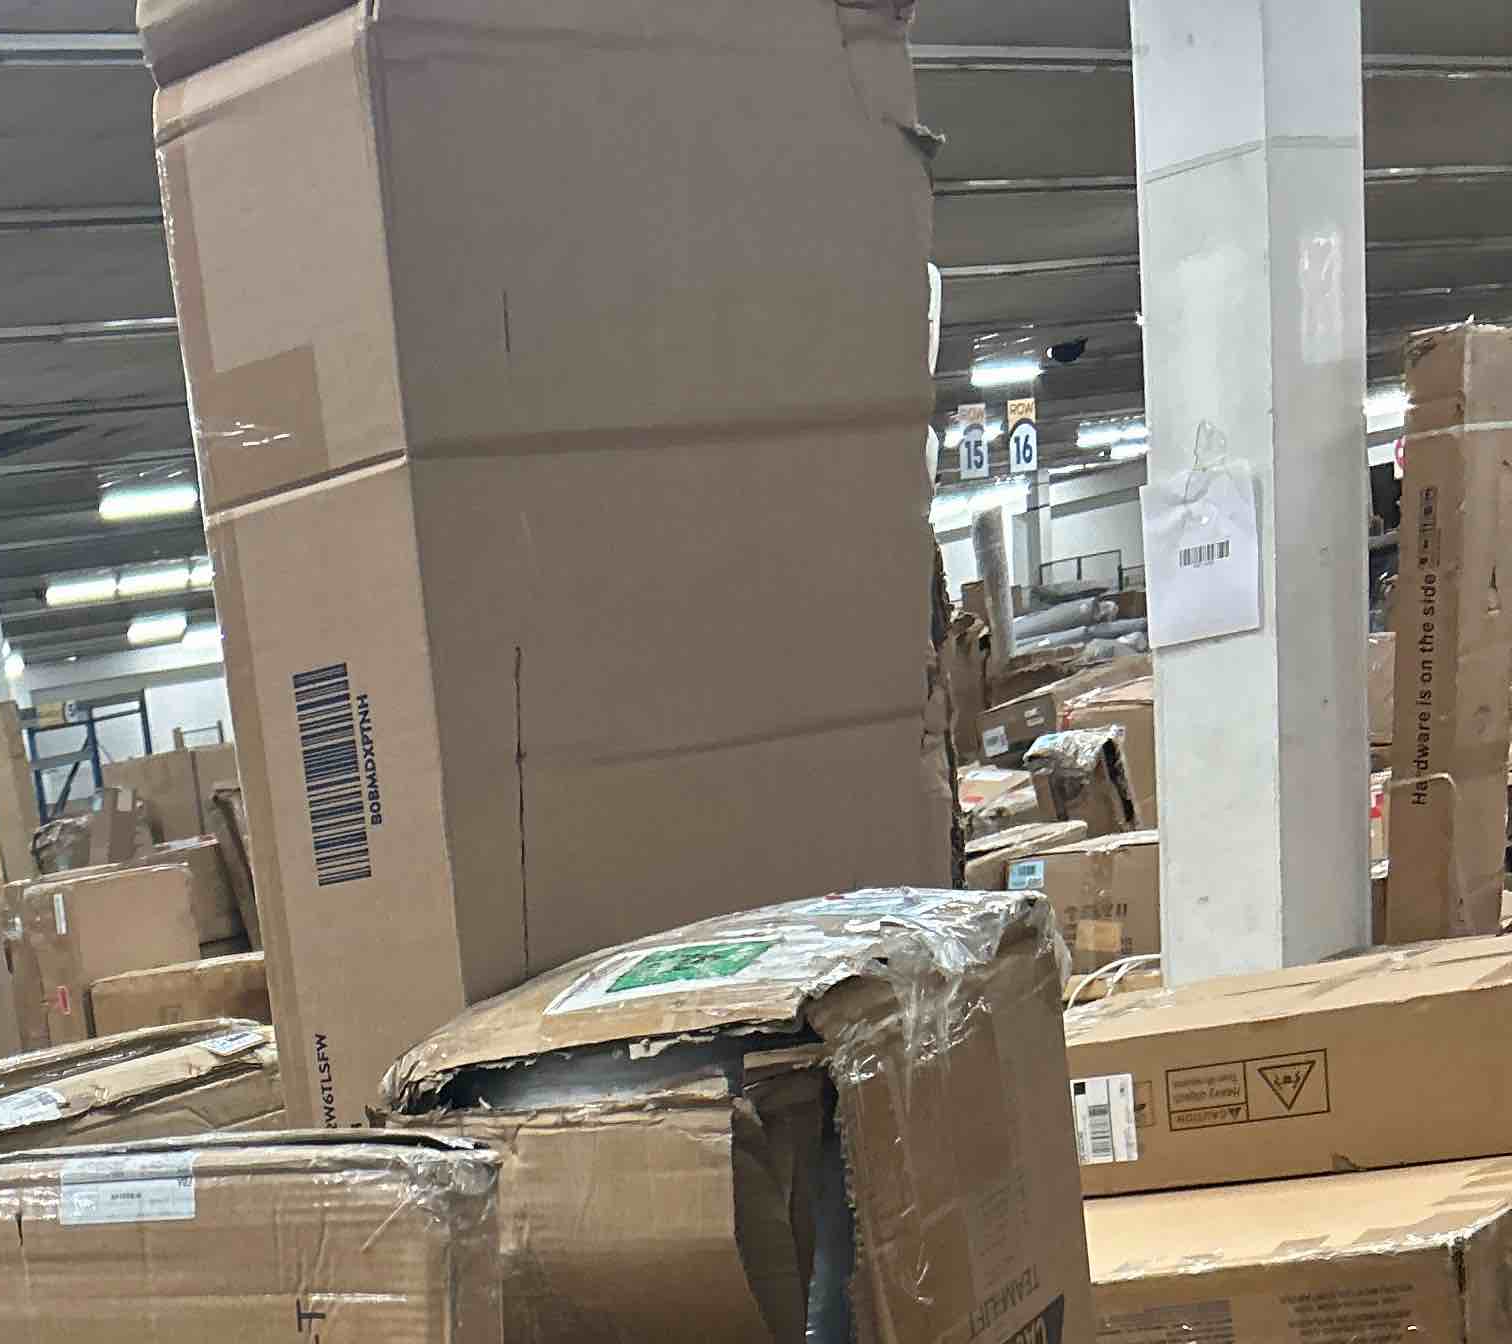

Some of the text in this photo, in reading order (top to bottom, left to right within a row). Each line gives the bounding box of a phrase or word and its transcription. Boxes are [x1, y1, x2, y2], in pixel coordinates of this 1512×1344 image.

[1010, 403, 1033, 415] ROW
[965, 440, 984, 469] 15
[1015, 434, 1032, 464] 16
[1411, 573, 1437, 805] Hardware is on the side
